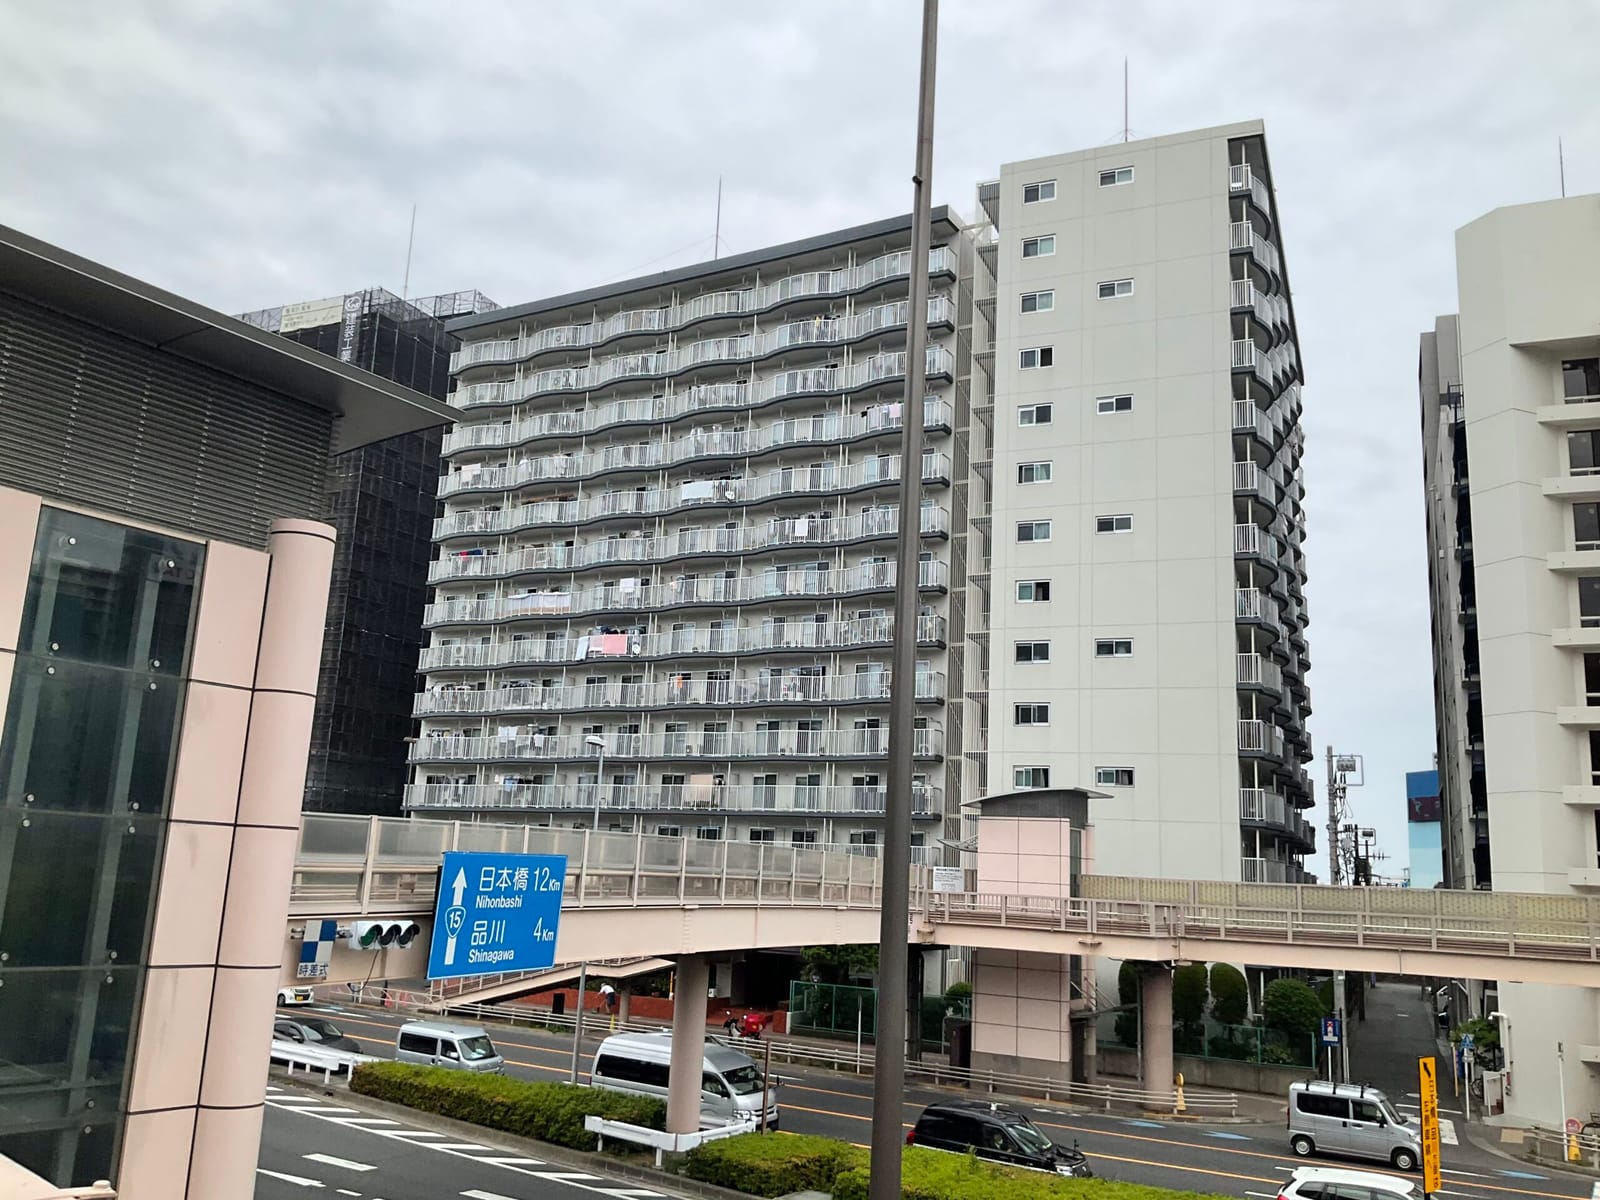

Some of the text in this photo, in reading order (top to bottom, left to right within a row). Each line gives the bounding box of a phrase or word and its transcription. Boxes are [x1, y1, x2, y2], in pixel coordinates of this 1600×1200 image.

[479, 866, 529, 892] 日本橋
[475, 894, 523, 909] Nihonbashi
[449, 910, 462, 929] 15
[471, 919, 506, 946] 品川
[468, 948, 515, 964] Shinagawa
[298, 963, 329, 977] 時差式
